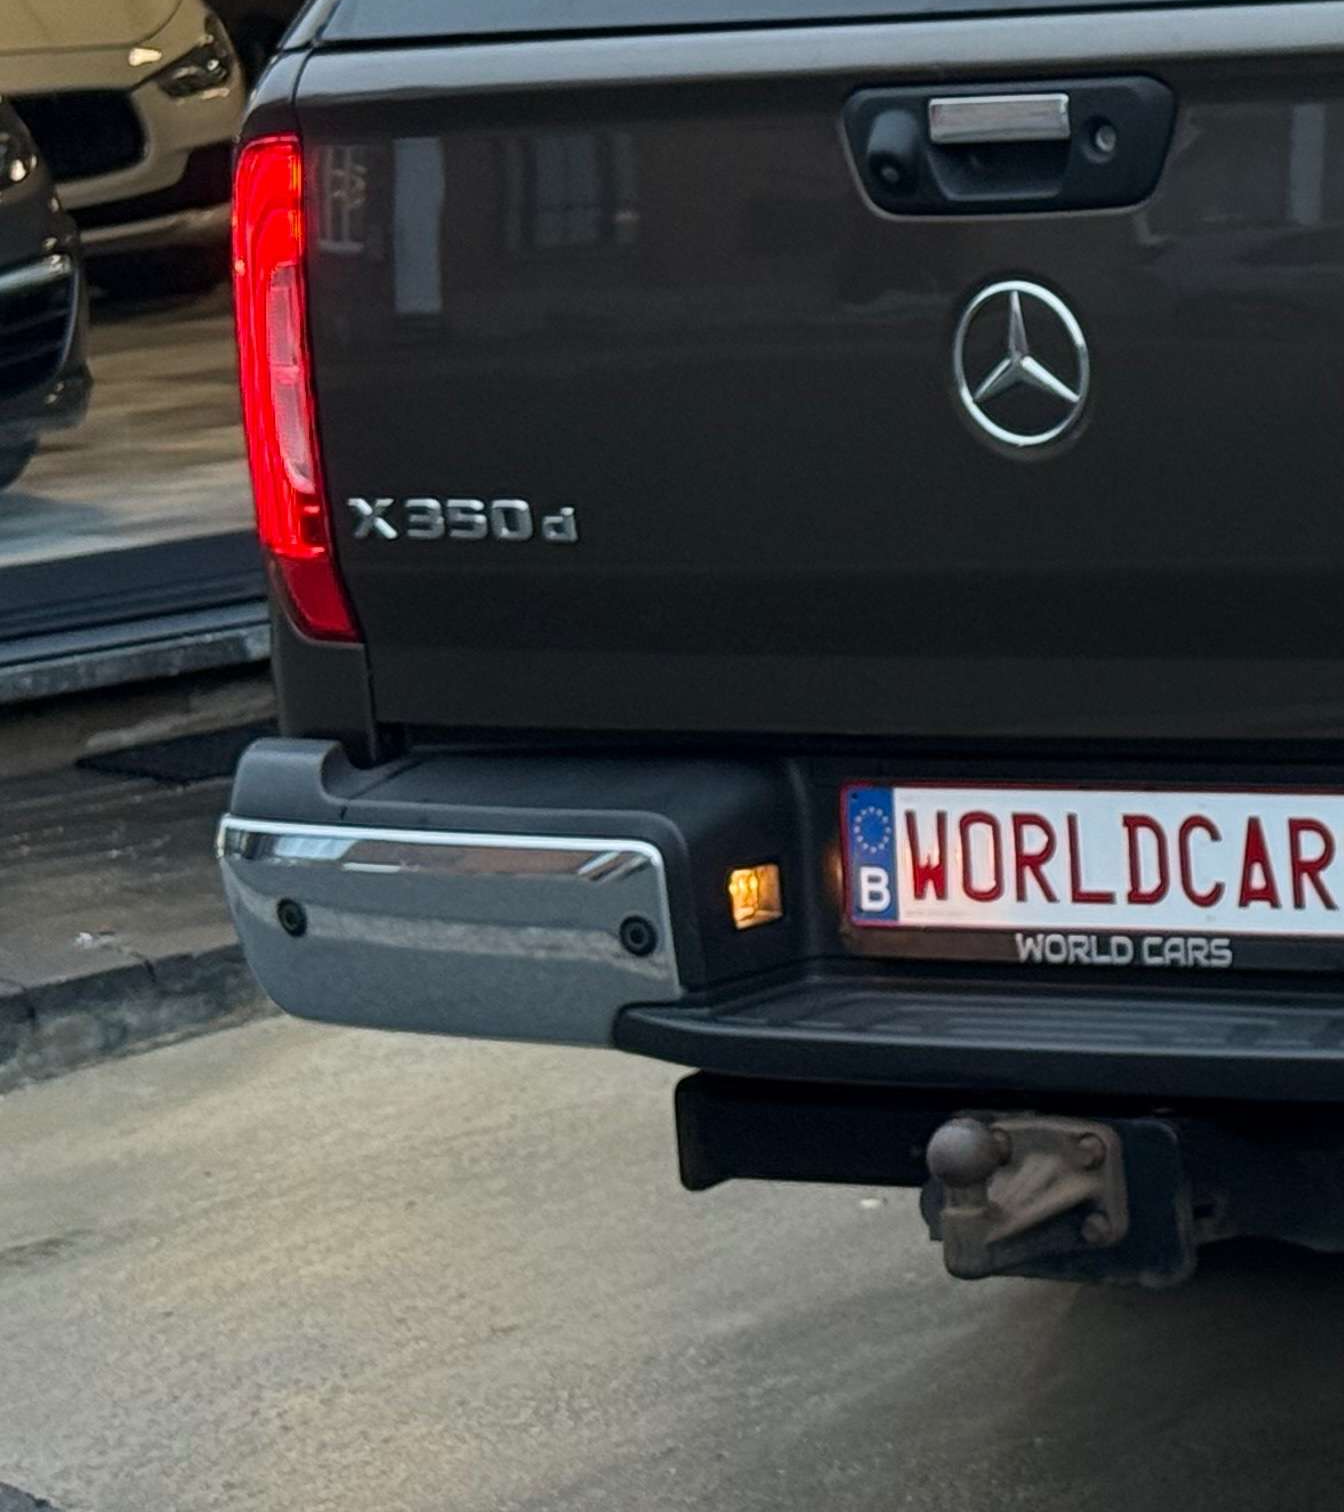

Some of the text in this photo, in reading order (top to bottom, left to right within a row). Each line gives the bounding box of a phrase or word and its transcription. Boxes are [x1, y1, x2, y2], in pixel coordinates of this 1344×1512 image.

[859, 867, 890, 913] B
[1016, 933, 1233, 968] WORLD CARS
